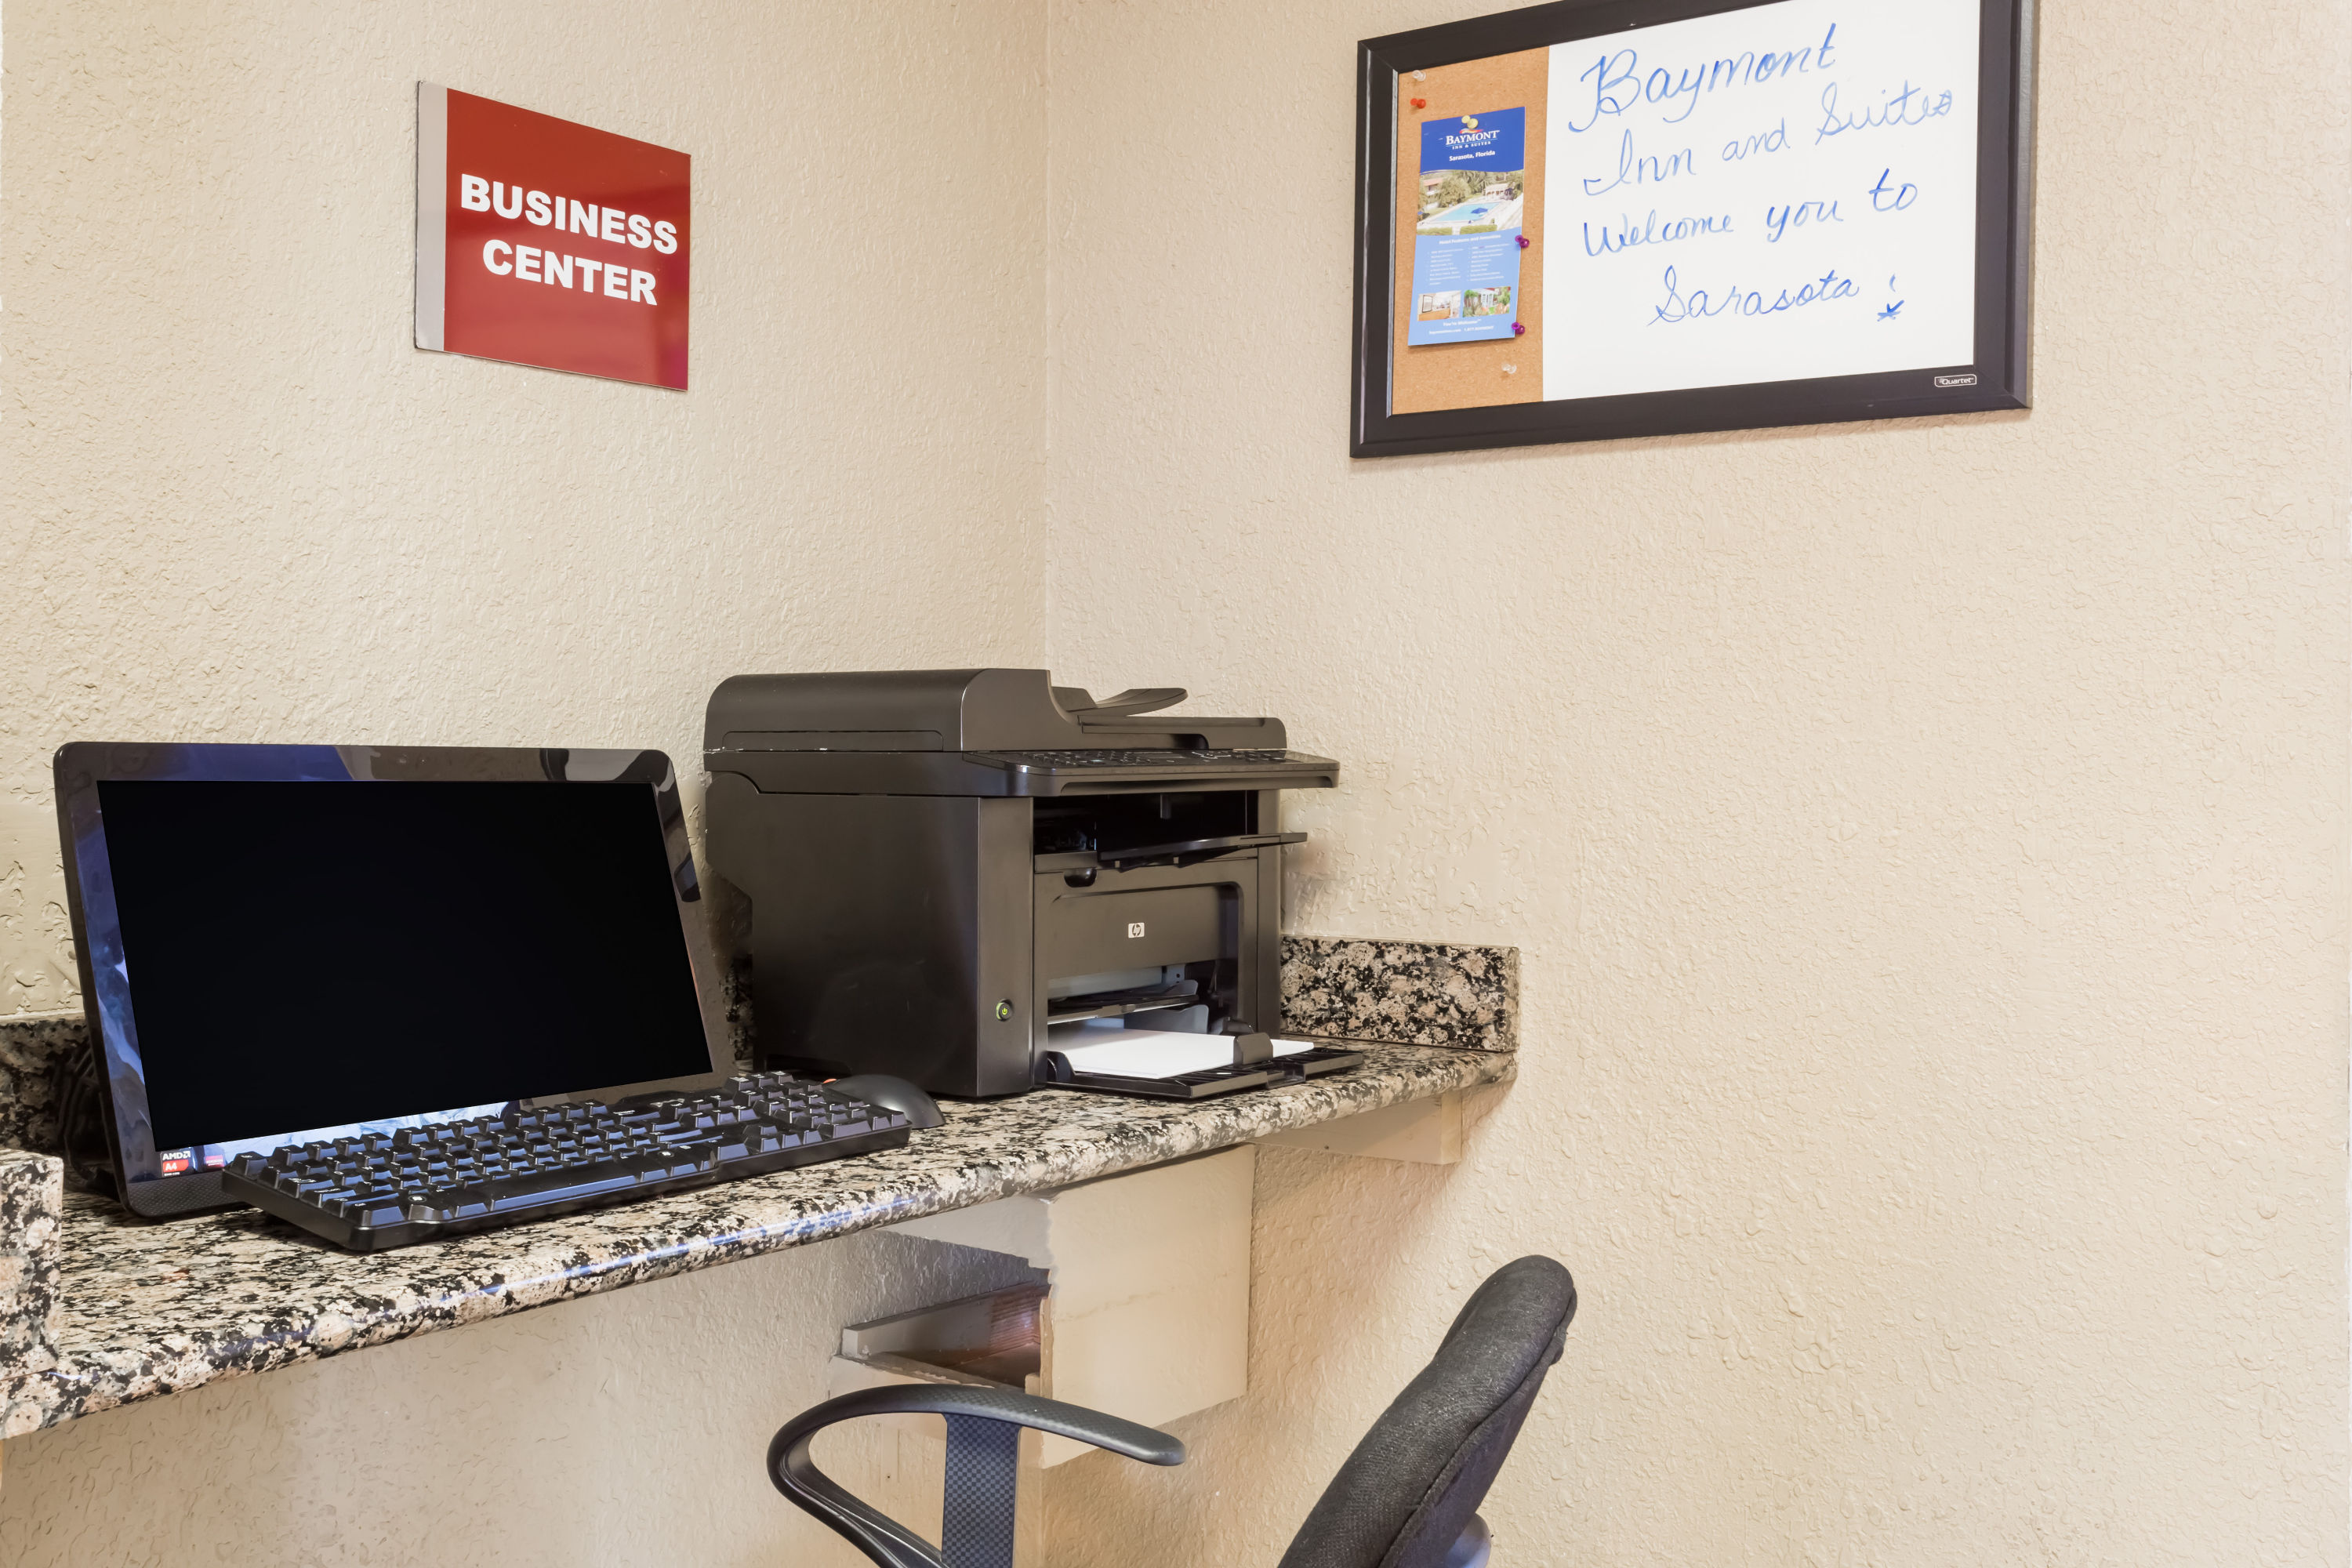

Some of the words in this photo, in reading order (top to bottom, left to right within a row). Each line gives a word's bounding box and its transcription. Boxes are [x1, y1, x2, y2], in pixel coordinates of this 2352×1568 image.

[1568, 22, 1837, 133] Baymont
[1446, 130, 1498, 145] BAYMONT
[1583, 129, 1697, 196] Inn
[1722, 118, 1791, 162] and
[1815, 81, 1952, 145] Suites
[461, 173, 678, 255] BUSINESS
[1584, 210, 1733, 257] Welcome
[1766, 200, 1844, 243] you
[1868, 167, 1918, 212] to
[482, 239, 658, 306] CENTER
[1647, 264, 1860, 325] Sarasota
[162, 1152, 186, 1161] AMD
[165, 1162, 178, 1171] A4
